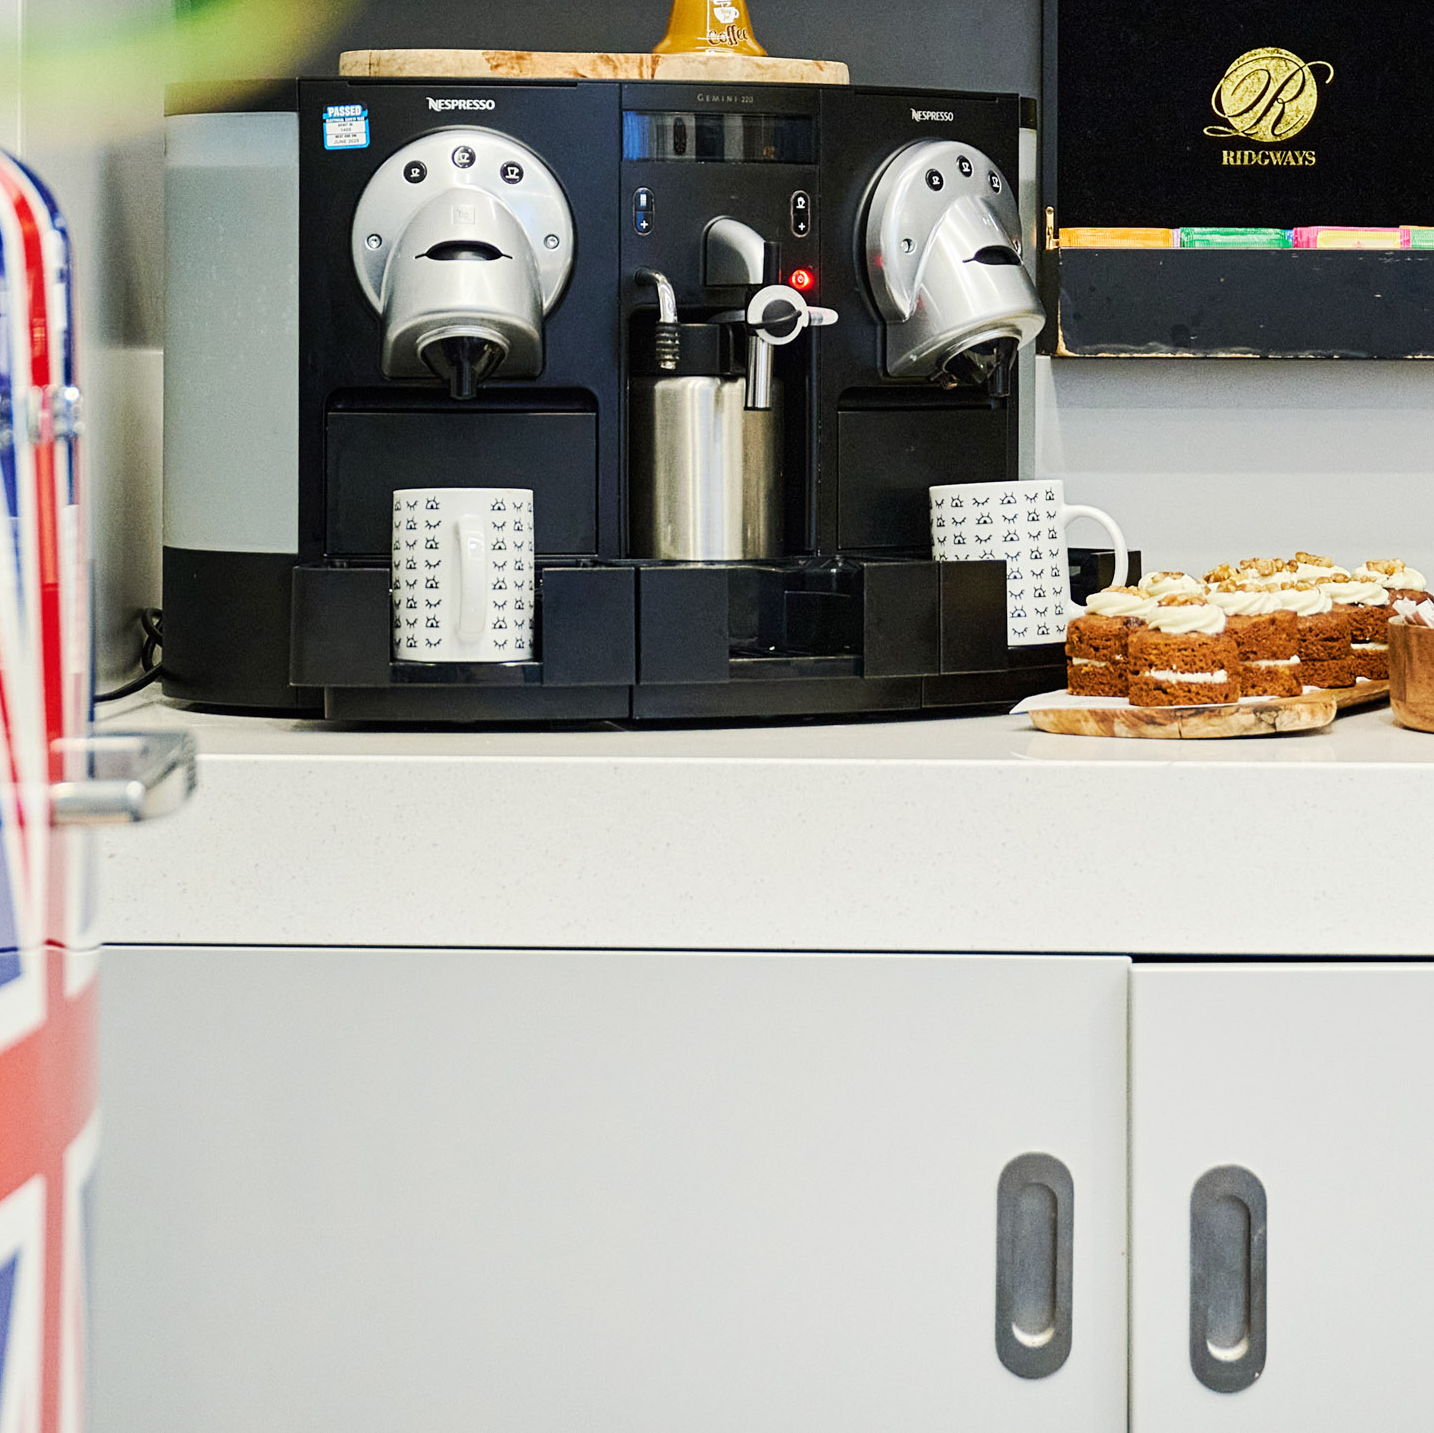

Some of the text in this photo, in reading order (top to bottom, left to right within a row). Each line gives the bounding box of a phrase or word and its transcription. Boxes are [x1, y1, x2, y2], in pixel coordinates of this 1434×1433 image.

[328, 105, 362, 118] PASSED
[425, 96, 496, 113] NESPRESSO
[910, 107, 955, 122] NESPRESSO
[1221, 149, 1317, 166] RIDGWAYS
